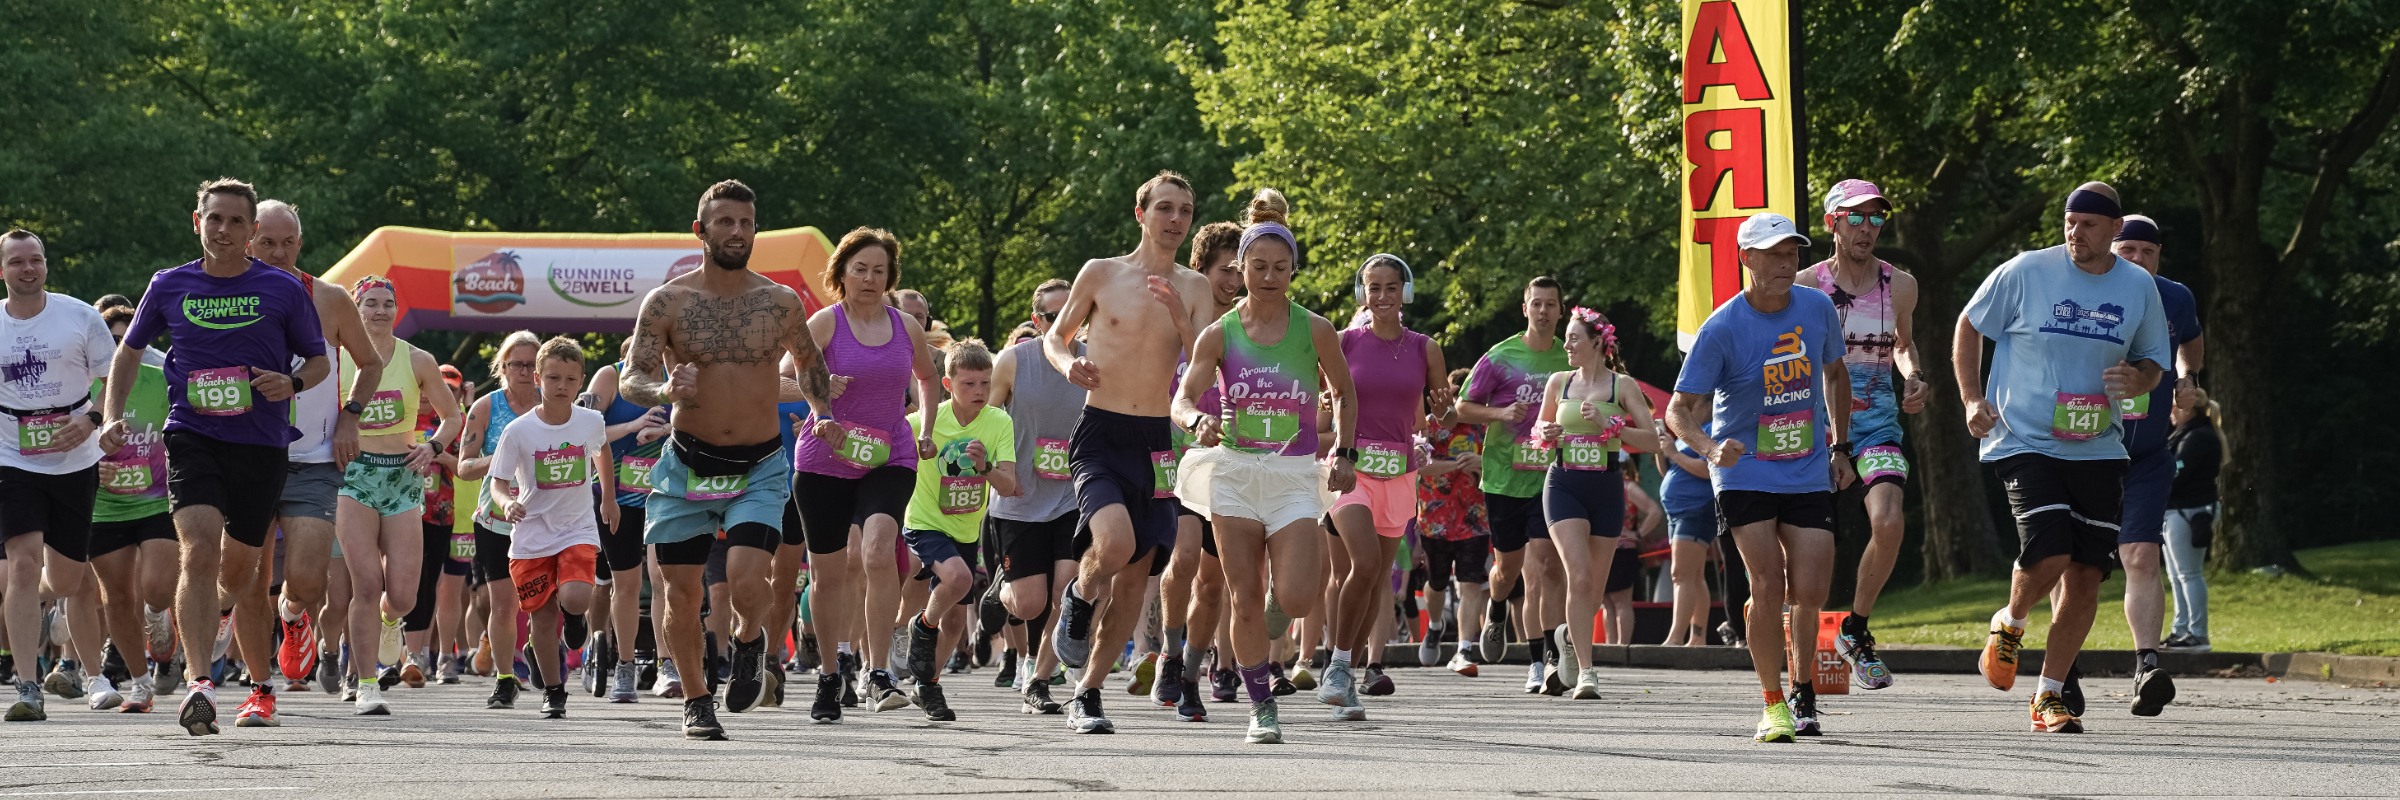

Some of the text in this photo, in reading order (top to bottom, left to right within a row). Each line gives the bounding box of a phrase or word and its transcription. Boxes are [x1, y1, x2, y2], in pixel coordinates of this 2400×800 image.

[552, 268, 634, 280] RUNNING
[465, 272, 518, 292] Beach
[562, 281, 634, 294] 2BWELL
[188, 296, 260, 310] RUNNING
[196, 306, 259, 320] 2BWELL
[17, 364, 45, 376] YARD
[1238, 362, 1280, 380] Around
[1763, 360, 1812, 385] RUN
[196, 376, 236, 388] Beach 5K
[1256, 378, 1274, 388] the
[197, 386, 240, 407] 199
[1516, 384, 1544, 404] Bea
[1764, 388, 1811, 406] RACING
[1246, 406, 1286, 416] Beach 5K
[2066, 400, 2092, 410] Beach
[364, 404, 396, 422] 215
[27, 420, 52, 430] Beach
[1262, 418, 1270, 438] 1
[1768, 419, 1804, 432] Beach 5K
[2068, 412, 2100, 430] 141
[28, 430, 50, 446] 19
[848, 430, 872, 444] Beach
[1570, 440, 1591, 448] Beach
[1774, 430, 1802, 450] 35
[136, 446, 152, 457] 5K
[852, 442, 874, 462] 16
[1044, 444, 1066, 454] Beach
[1366, 446, 1390, 456] Beach
[1568, 448, 1600, 463] 109
[544, 455, 568, 466] Beach
[1521, 450, 1548, 463] 143
[1361, 456, 1400, 474] 226
[1866, 456, 1906, 472] 223
[110, 471, 145, 486] 222
[550, 464, 574, 481] 57
[696, 474, 743, 491] 207
[950, 482, 973, 490] Beach
[948, 490, 981, 506] 185
[456, 544, 476, 557] 170
[516, 574, 548, 593] NDER
[1817, 673, 1847, 685] THIS.
